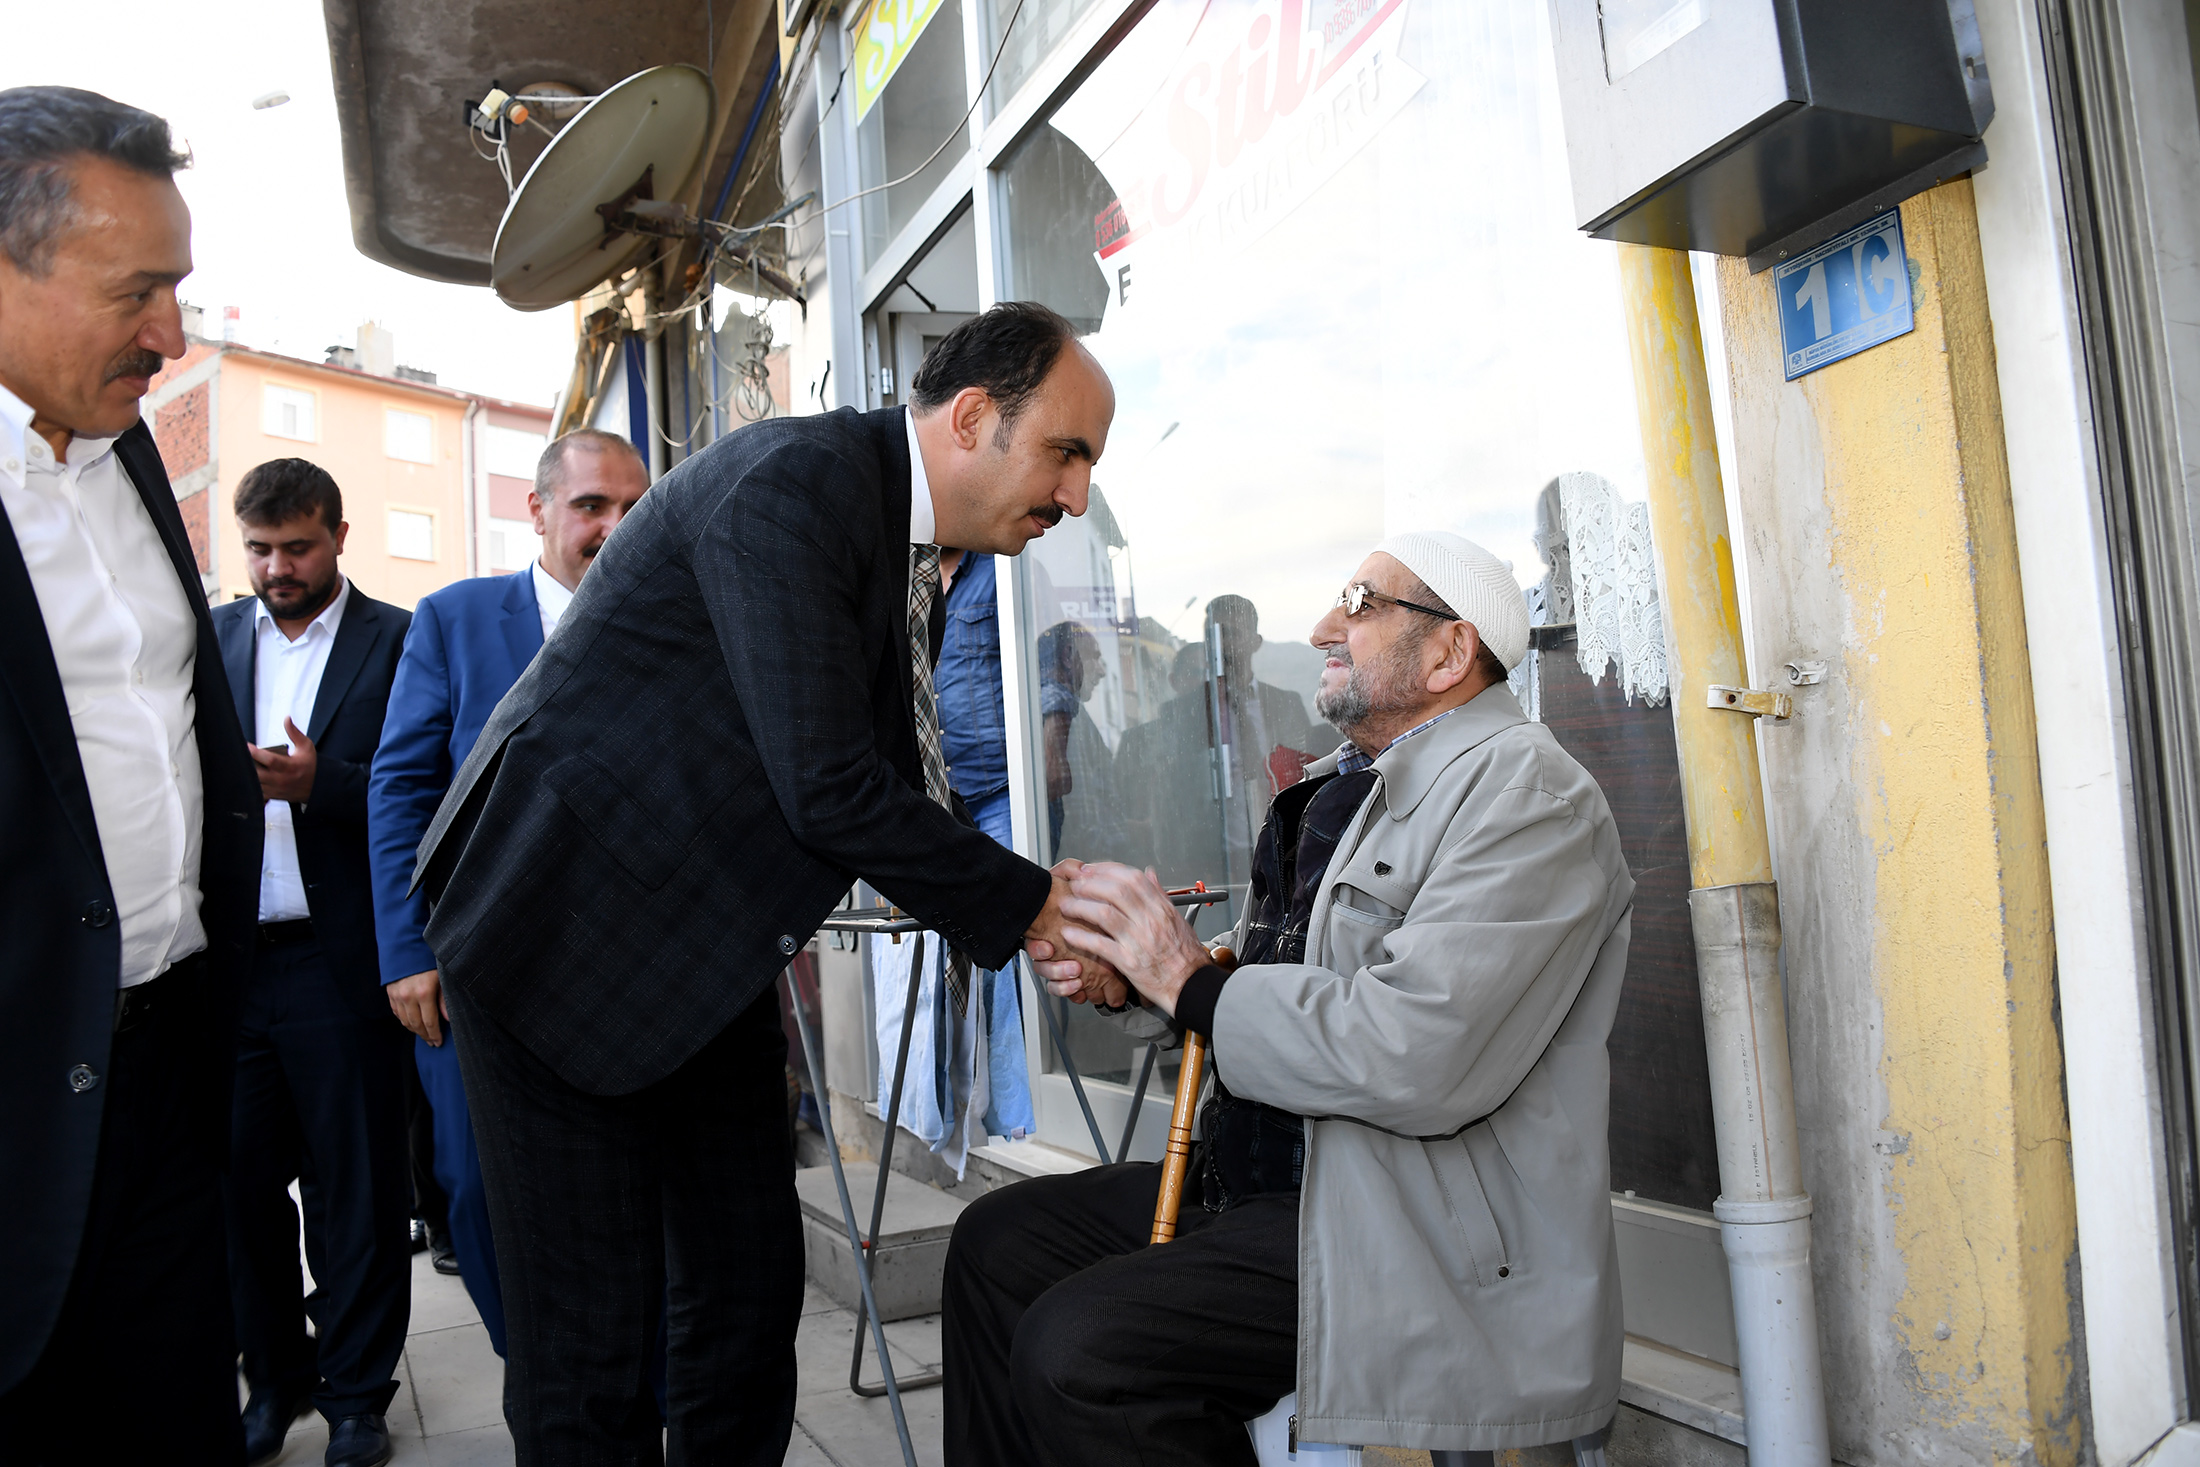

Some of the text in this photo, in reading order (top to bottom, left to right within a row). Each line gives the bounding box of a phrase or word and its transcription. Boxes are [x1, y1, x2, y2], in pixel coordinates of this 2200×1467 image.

[1152, 0, 1316, 227] Stil
[1795, 235, 1895, 341] 1 C
